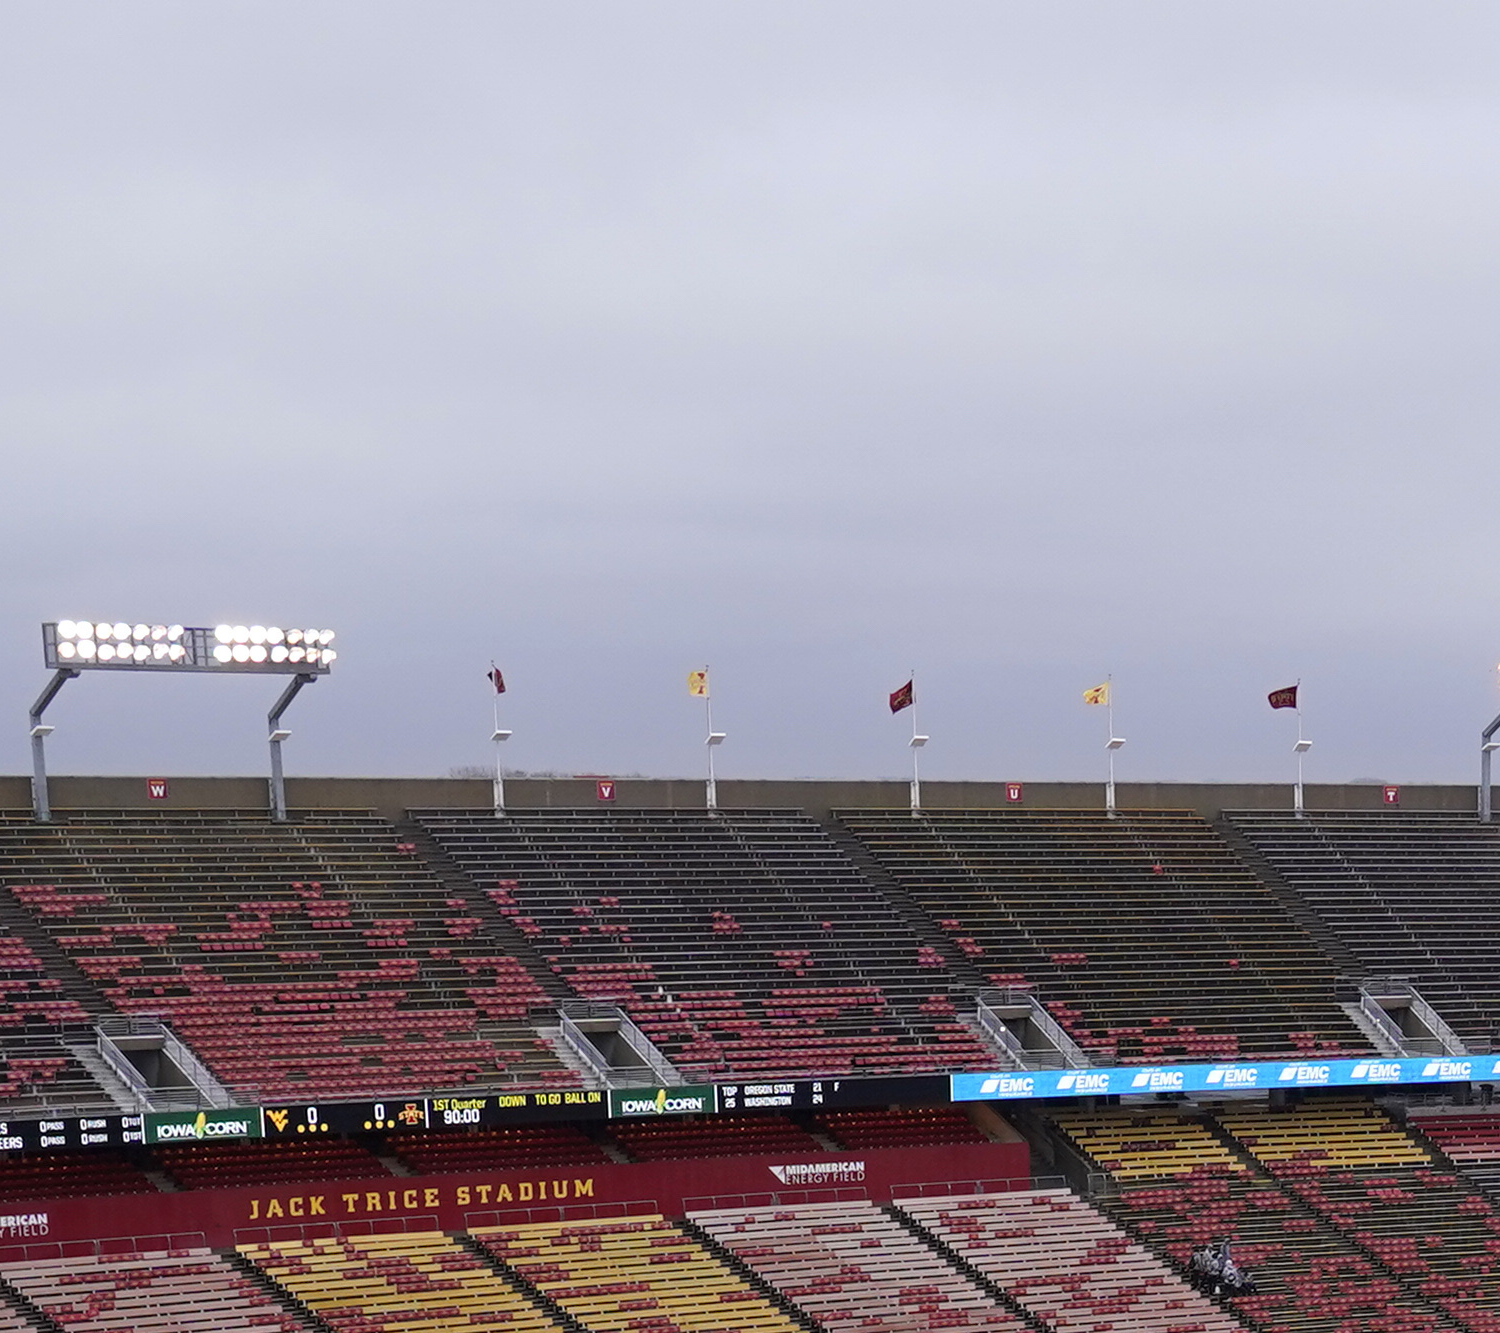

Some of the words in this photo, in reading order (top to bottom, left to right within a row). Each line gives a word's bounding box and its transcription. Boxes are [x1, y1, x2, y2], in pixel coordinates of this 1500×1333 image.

[722, 1085, 738, 1097] TOP
[773, 1083, 796, 1095] STATE
[451, 1097, 486, 1111] Quarter
[499, 1094, 526, 1107] DOWN
[535, 1093, 547, 1106] TO
[549, 1093, 562, 1105] GO
[564, 1091, 586, 1105] BALL
[587, 1091, 601, 1103] ON
[621, 1099, 657, 1114] IOWA
[664, 1096, 703, 1112] CORN
[744, 1095, 792, 1108] WASHINGTON
[307, 1107, 318, 1125] 0
[375, 1103, 385, 1121] 0
[443, 1109, 480, 1124] 90:00
[157, 1121, 197, 1139] IOWA
[204, 1119, 248, 1136] CORN
[785, 1161, 866, 1177] MIDAMERICAN
[786, 1172, 831, 1186] ENERGY
[832, 1170, 866, 1183] FIELD
[249, 1195, 326, 1221] JACK
[345, 1187, 441, 1213] TRICE
[456, 1178, 596, 1207] STADIUM
[10, 1223, 50, 1239] FIELD
